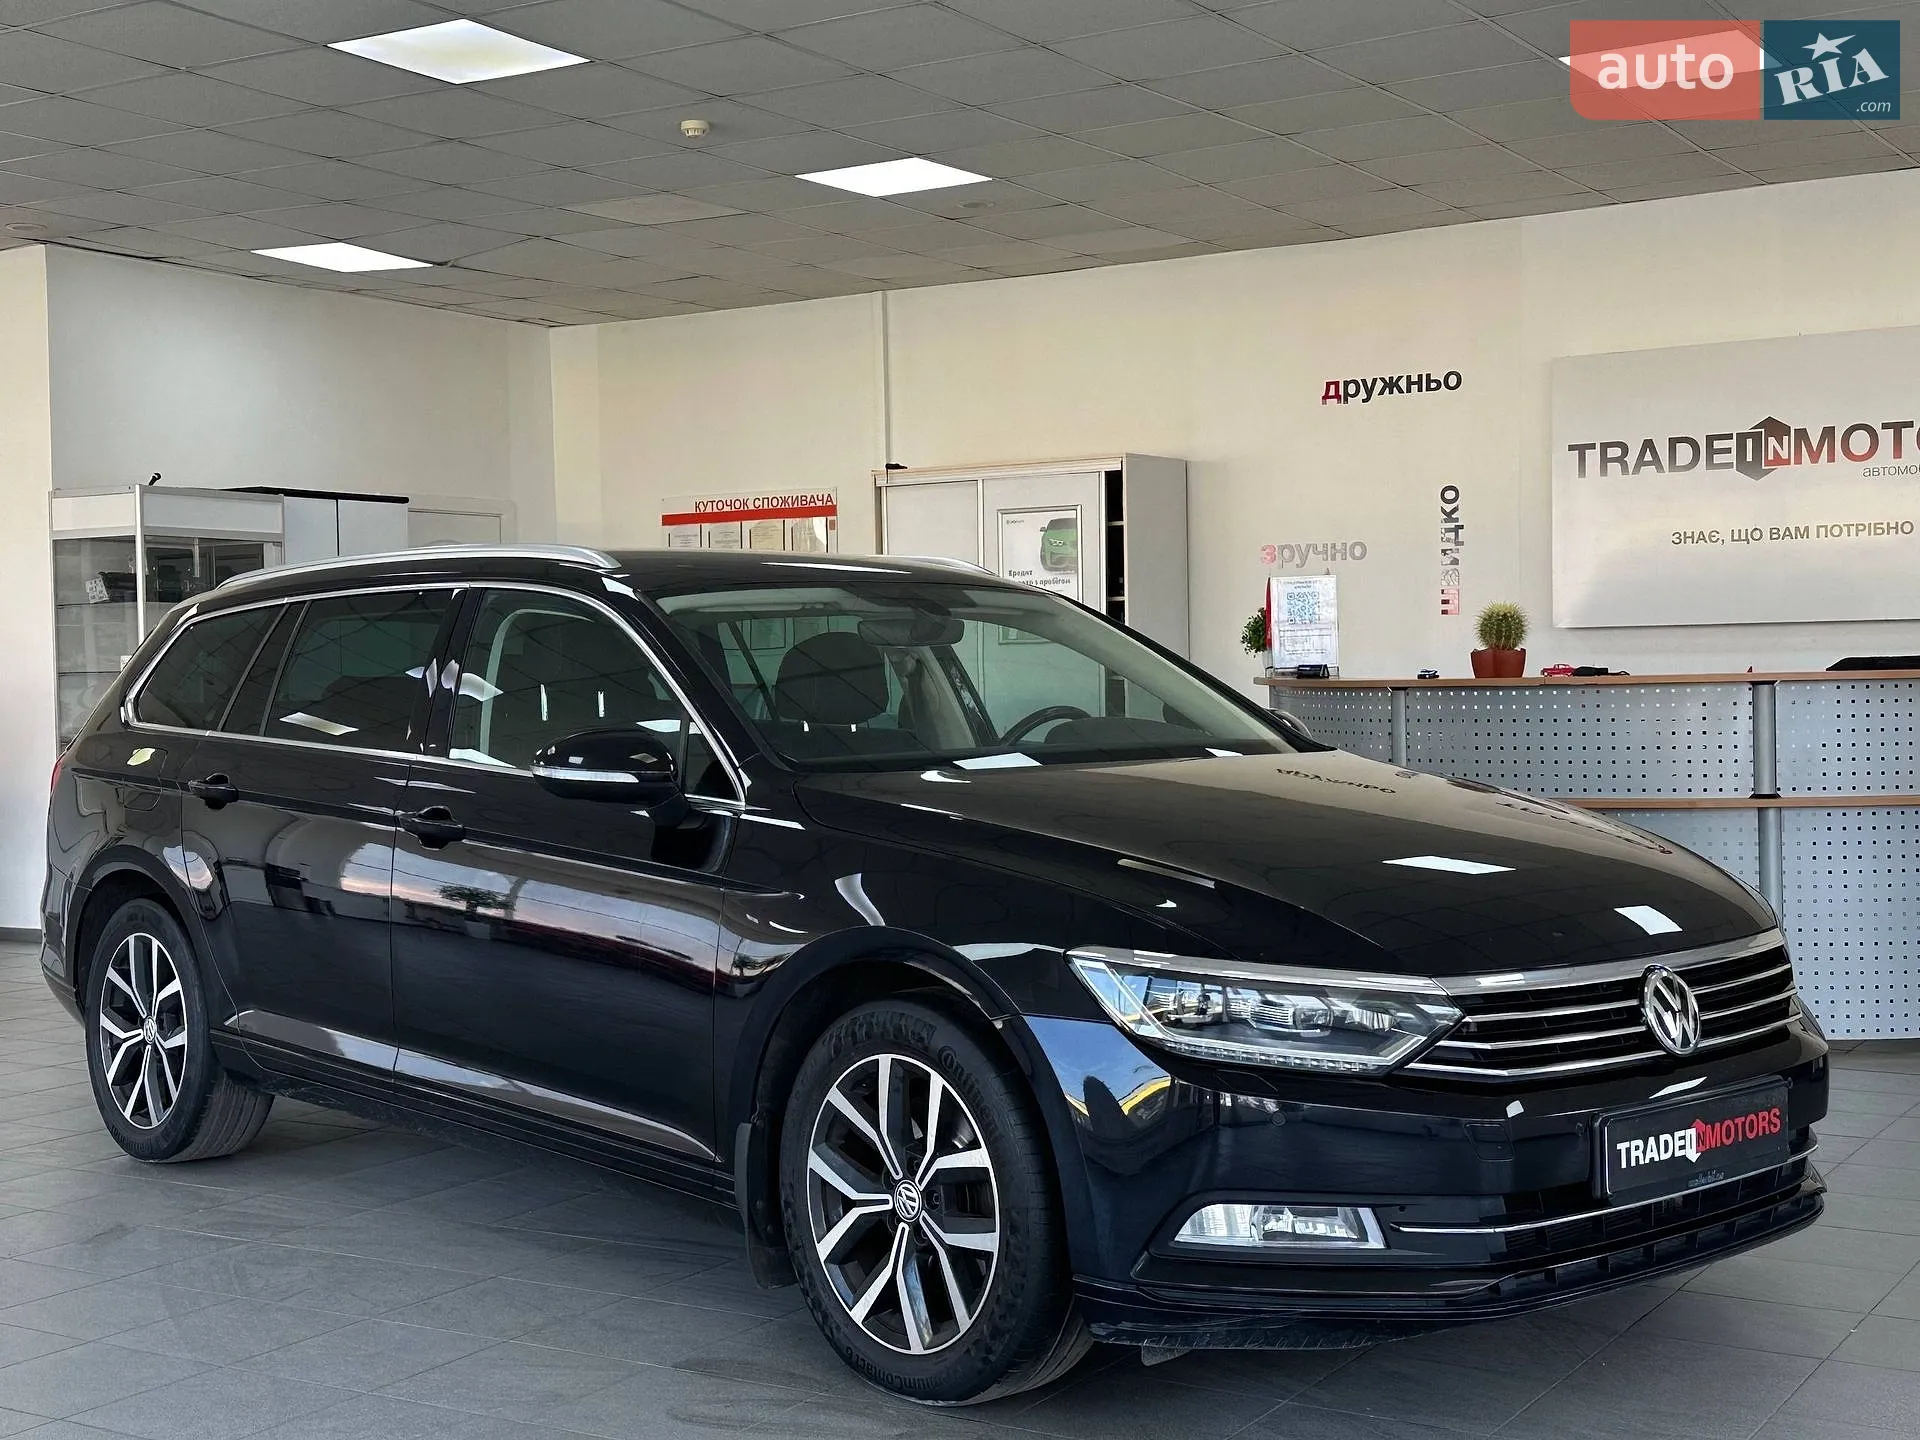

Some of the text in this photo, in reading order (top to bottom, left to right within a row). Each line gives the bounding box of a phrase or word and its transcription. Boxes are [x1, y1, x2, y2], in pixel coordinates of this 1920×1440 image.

[1321, 370, 1462, 404] дружньо
[1794, 419, 1920, 465] MOT
[1862, 464, 1920, 477] автомо
[694, 493, 834, 513] КУТОЧОК СПОЖИВАЧА
[1671, 520, 1915, 546] ЗНАЄ, ЩО ВАМ ПОТРІБНО
[1260, 540, 1368, 569] зручно
[1440, 484, 1464, 615] швидко
